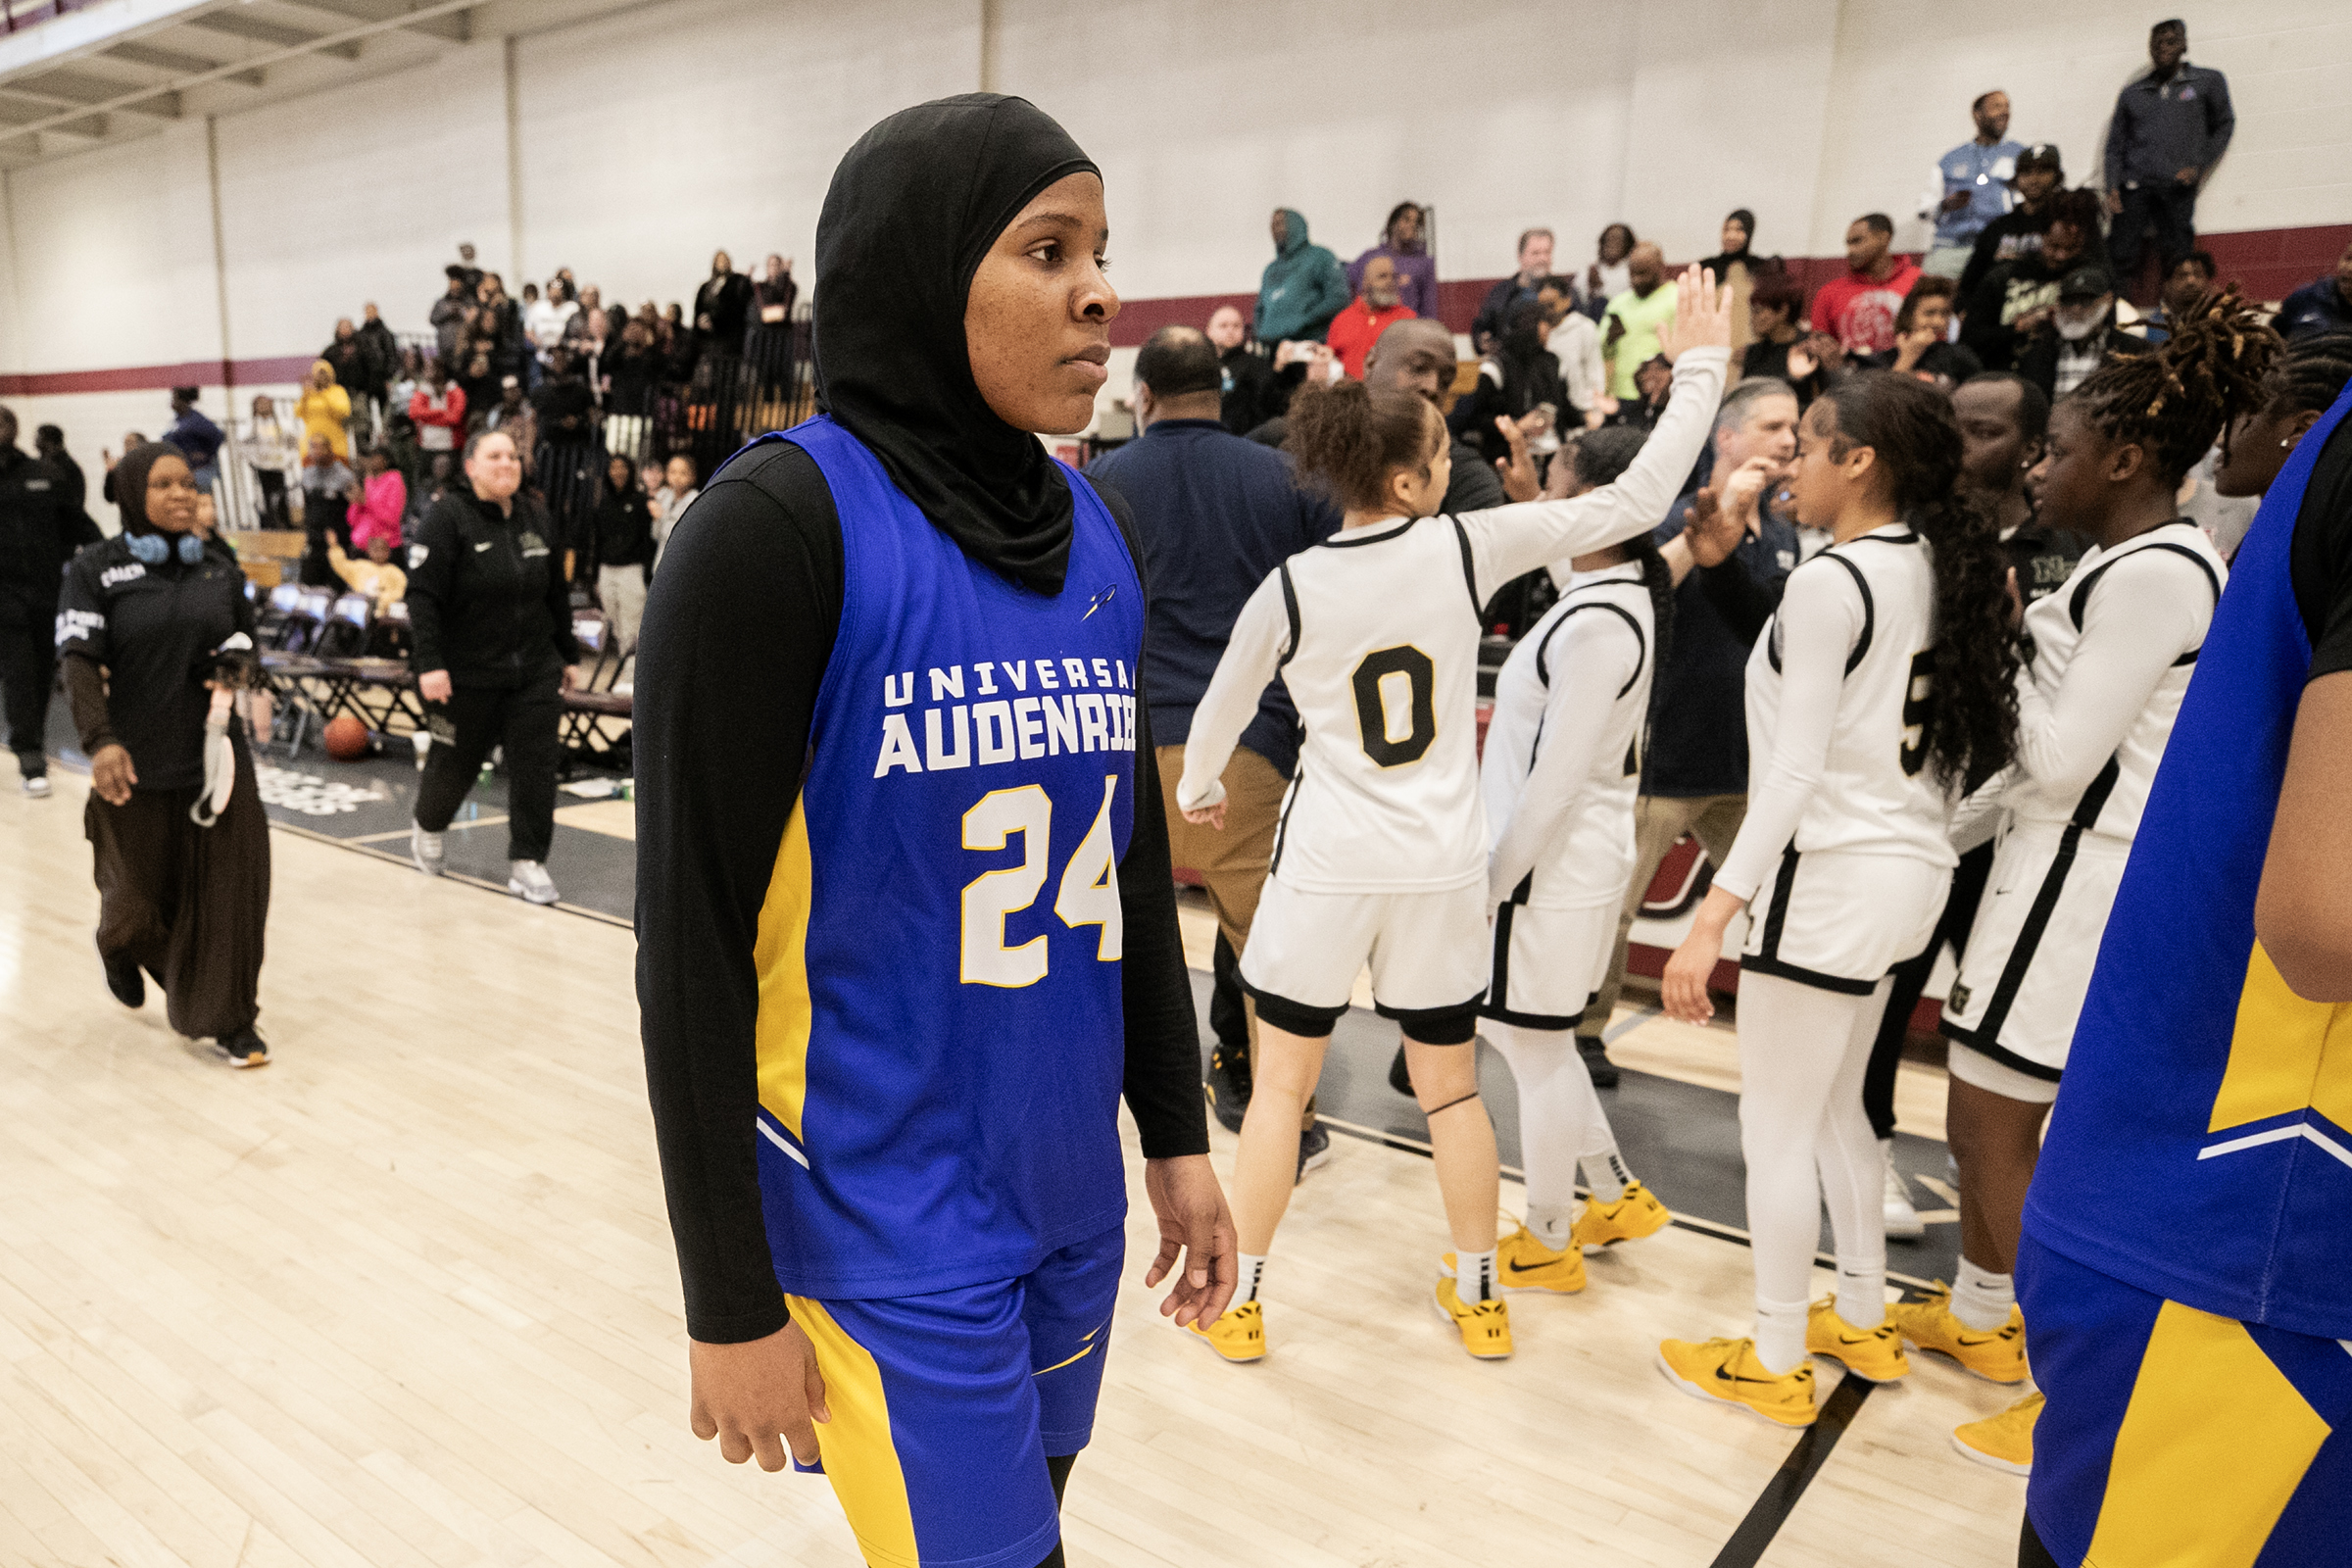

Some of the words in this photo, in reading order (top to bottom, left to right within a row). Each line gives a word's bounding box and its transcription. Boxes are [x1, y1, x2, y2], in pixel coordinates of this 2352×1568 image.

[884, 658, 1136, 708] UNIVERSA
[1348, 643, 1438, 770] 0
[959, 774, 1123, 989] 24
